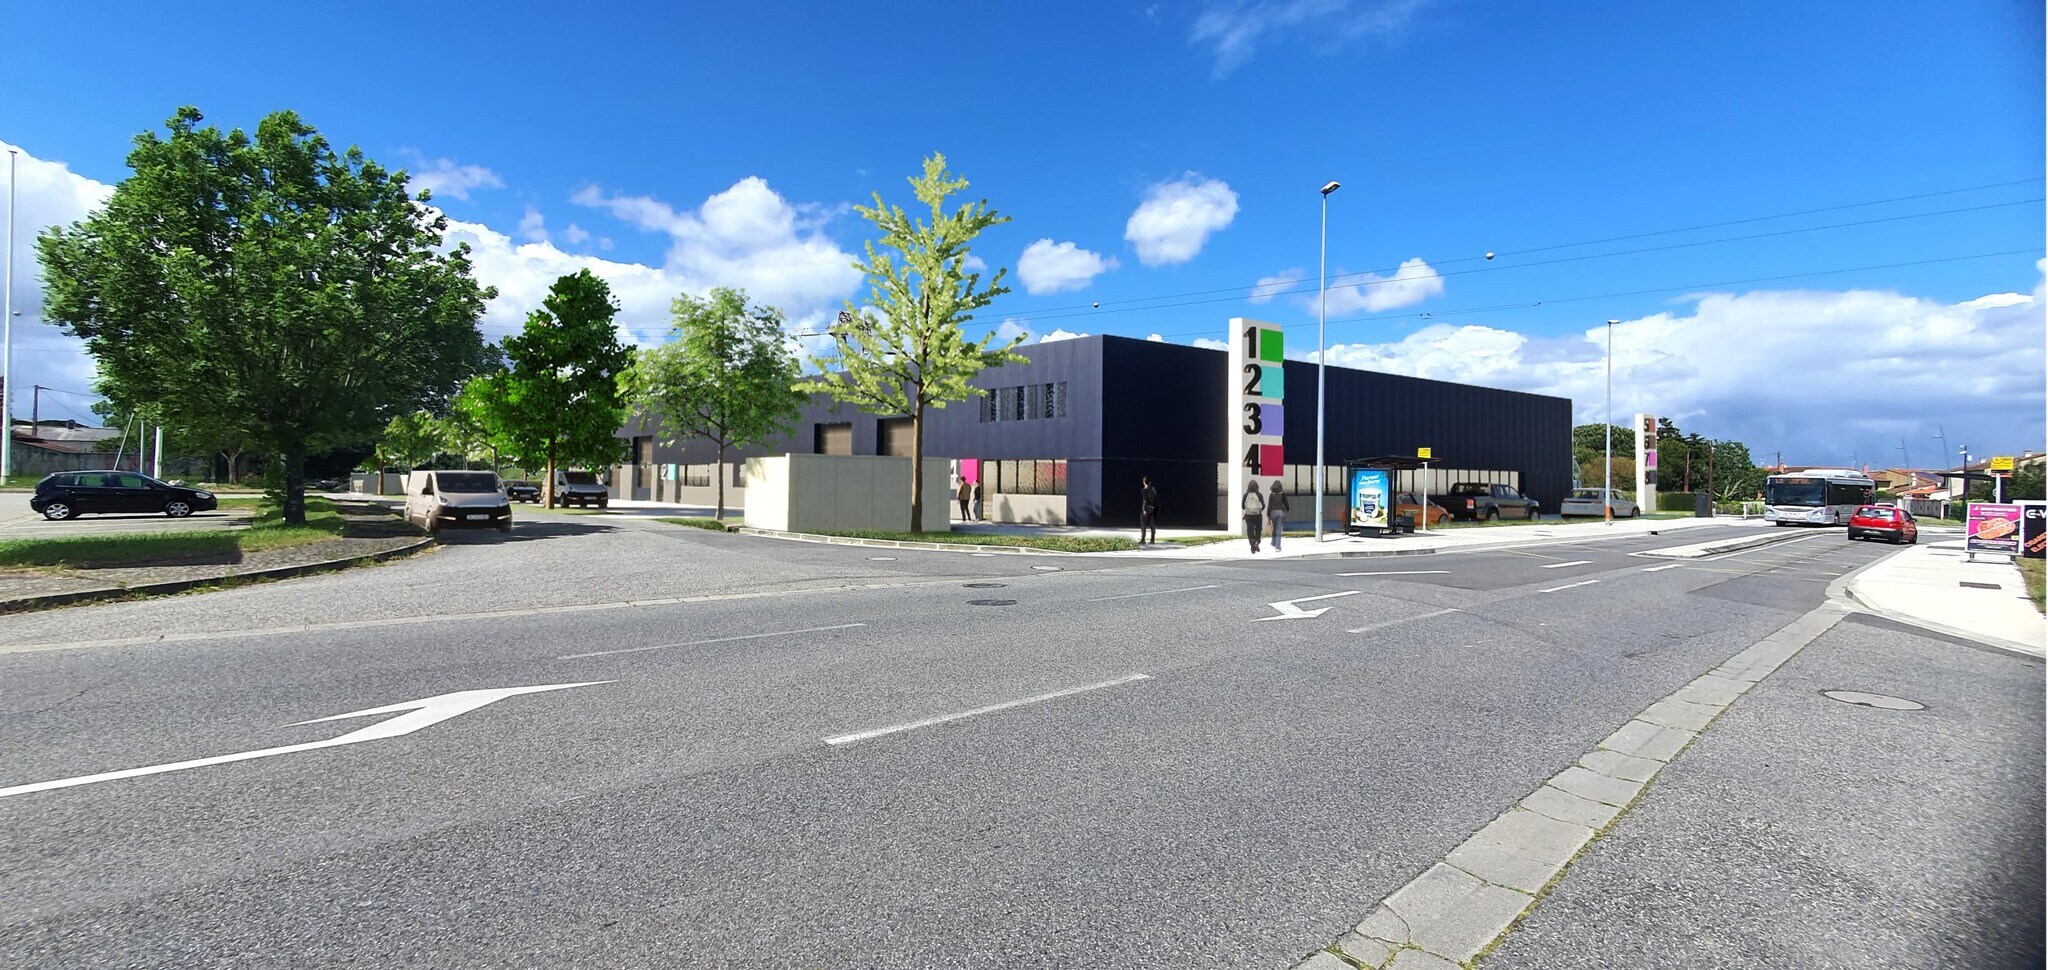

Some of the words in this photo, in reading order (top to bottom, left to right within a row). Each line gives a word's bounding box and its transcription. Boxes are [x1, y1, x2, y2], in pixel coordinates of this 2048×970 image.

[1243, 327, 1256, 358] 1
[1243, 364, 1262, 396] 2
[1243, 402, 1262, 435] 3
[660, 463, 667, 480] 2
[1242, 444, 1261, 475] 4
[1645, 452, 1651, 467] 7
